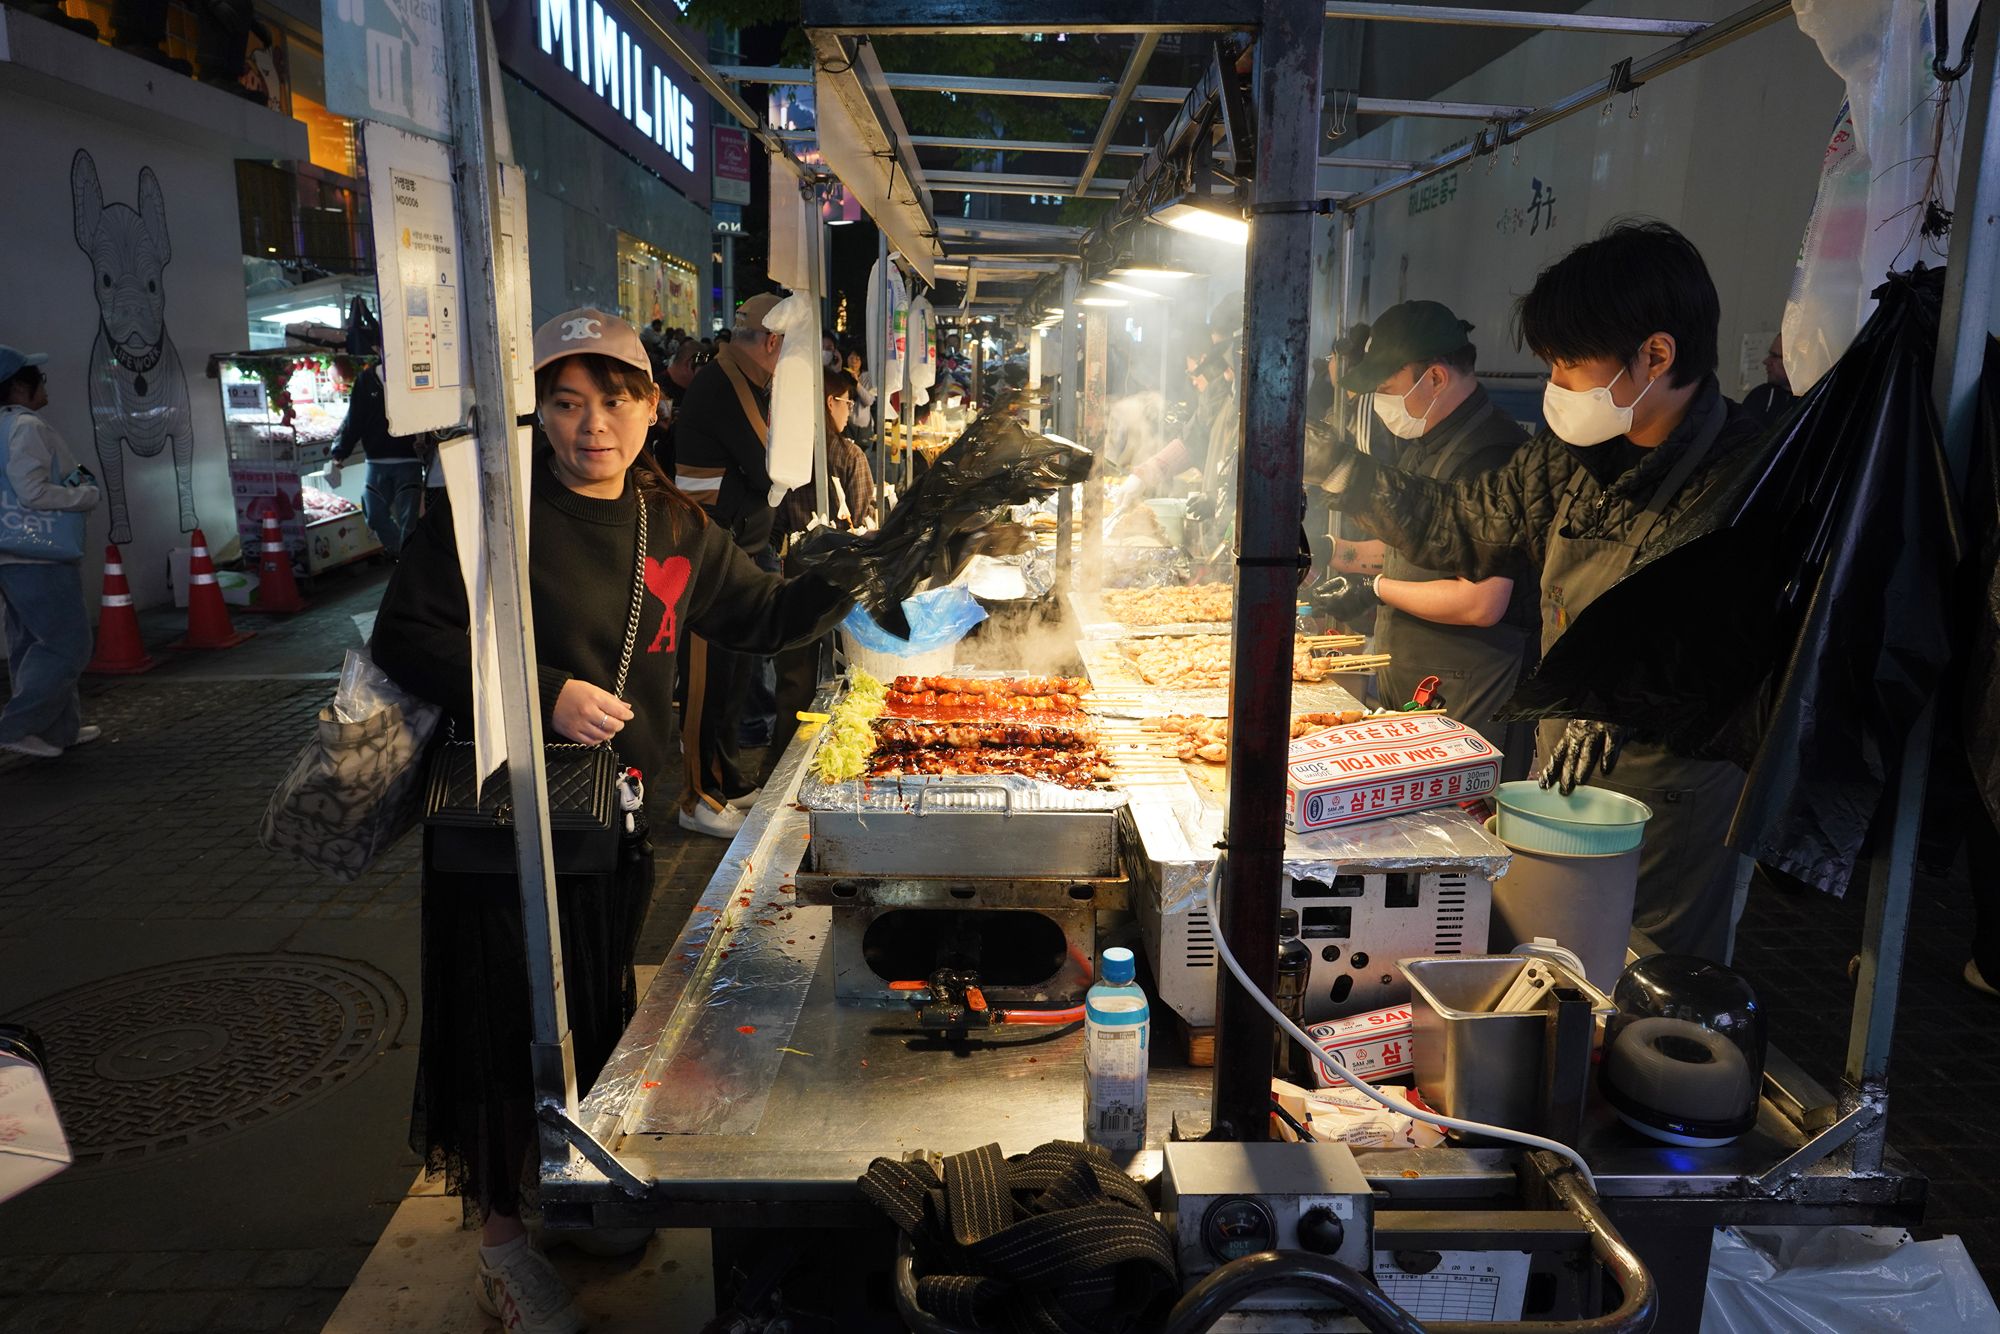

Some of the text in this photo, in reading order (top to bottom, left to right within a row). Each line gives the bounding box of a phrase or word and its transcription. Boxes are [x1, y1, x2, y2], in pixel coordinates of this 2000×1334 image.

[540, 0, 694, 173] MIMILINE
[113, 344, 161, 372] LIFEWORK
[1, 511, 56, 533] CAT
[1296, 762, 1328, 773] 30m
[1330, 746, 1448, 772] SAM JIN FOIL
[1465, 778, 1490, 792] 30m
[1467, 770, 1490, 779] 300mm
[1350, 775, 1462, 813] 삼진쿠킹호일
